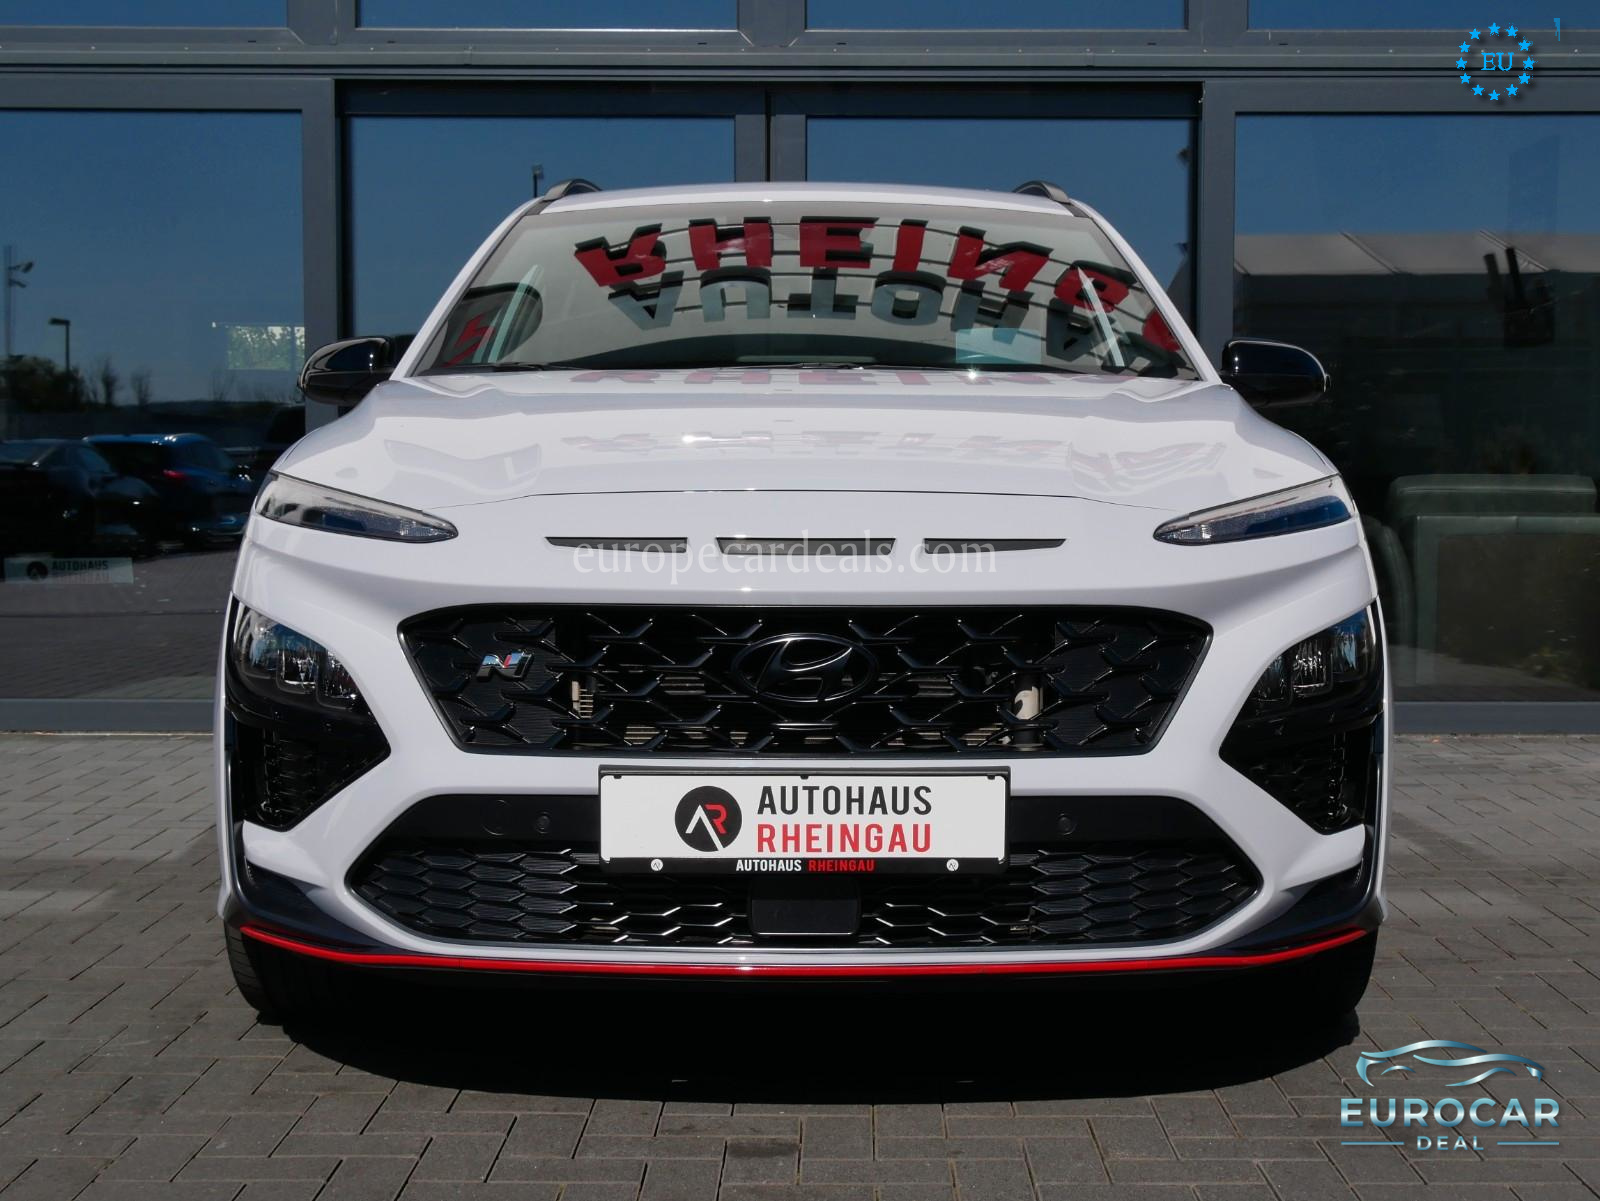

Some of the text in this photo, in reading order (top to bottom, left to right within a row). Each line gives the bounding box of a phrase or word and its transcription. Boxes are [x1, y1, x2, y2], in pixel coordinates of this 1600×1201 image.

[52, 560, 109, 570] AUTOHAUS
[757, 785, 932, 815] AUTOHAUS
[757, 823, 931, 853] RHEINGAU
[736, 859, 875, 872] AUTOHAUS RHEINGAU
